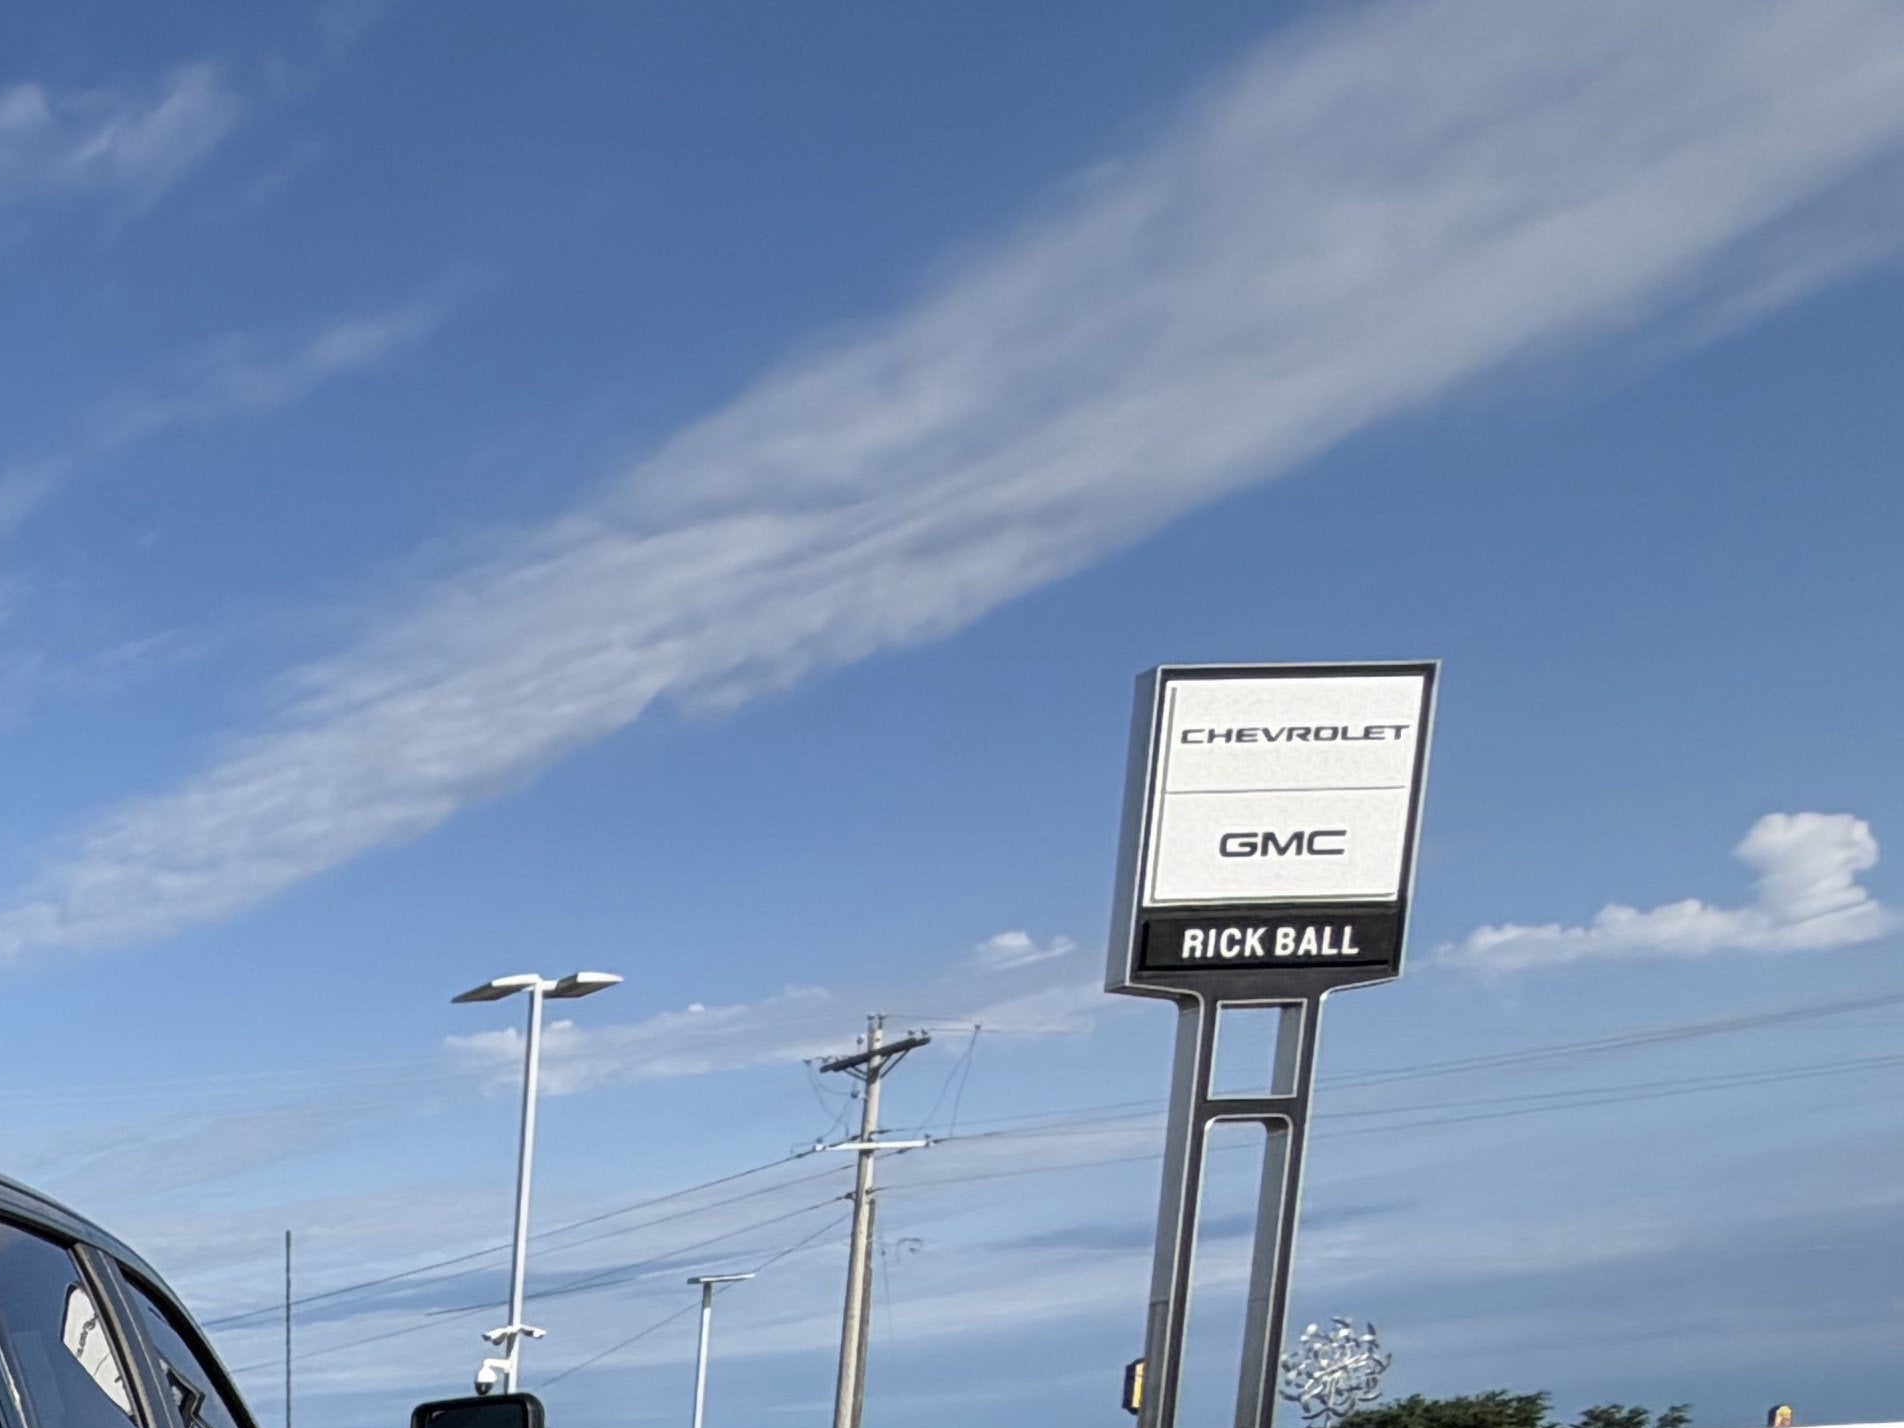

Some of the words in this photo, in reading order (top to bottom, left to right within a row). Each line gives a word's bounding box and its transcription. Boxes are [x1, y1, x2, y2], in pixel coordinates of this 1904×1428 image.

[1180, 724, 1410, 744] CHEVROLET
[1218, 829, 1347, 858] GMC
[1181, 927, 1267, 960] RICK
[1274, 925, 1360, 957] BALL
